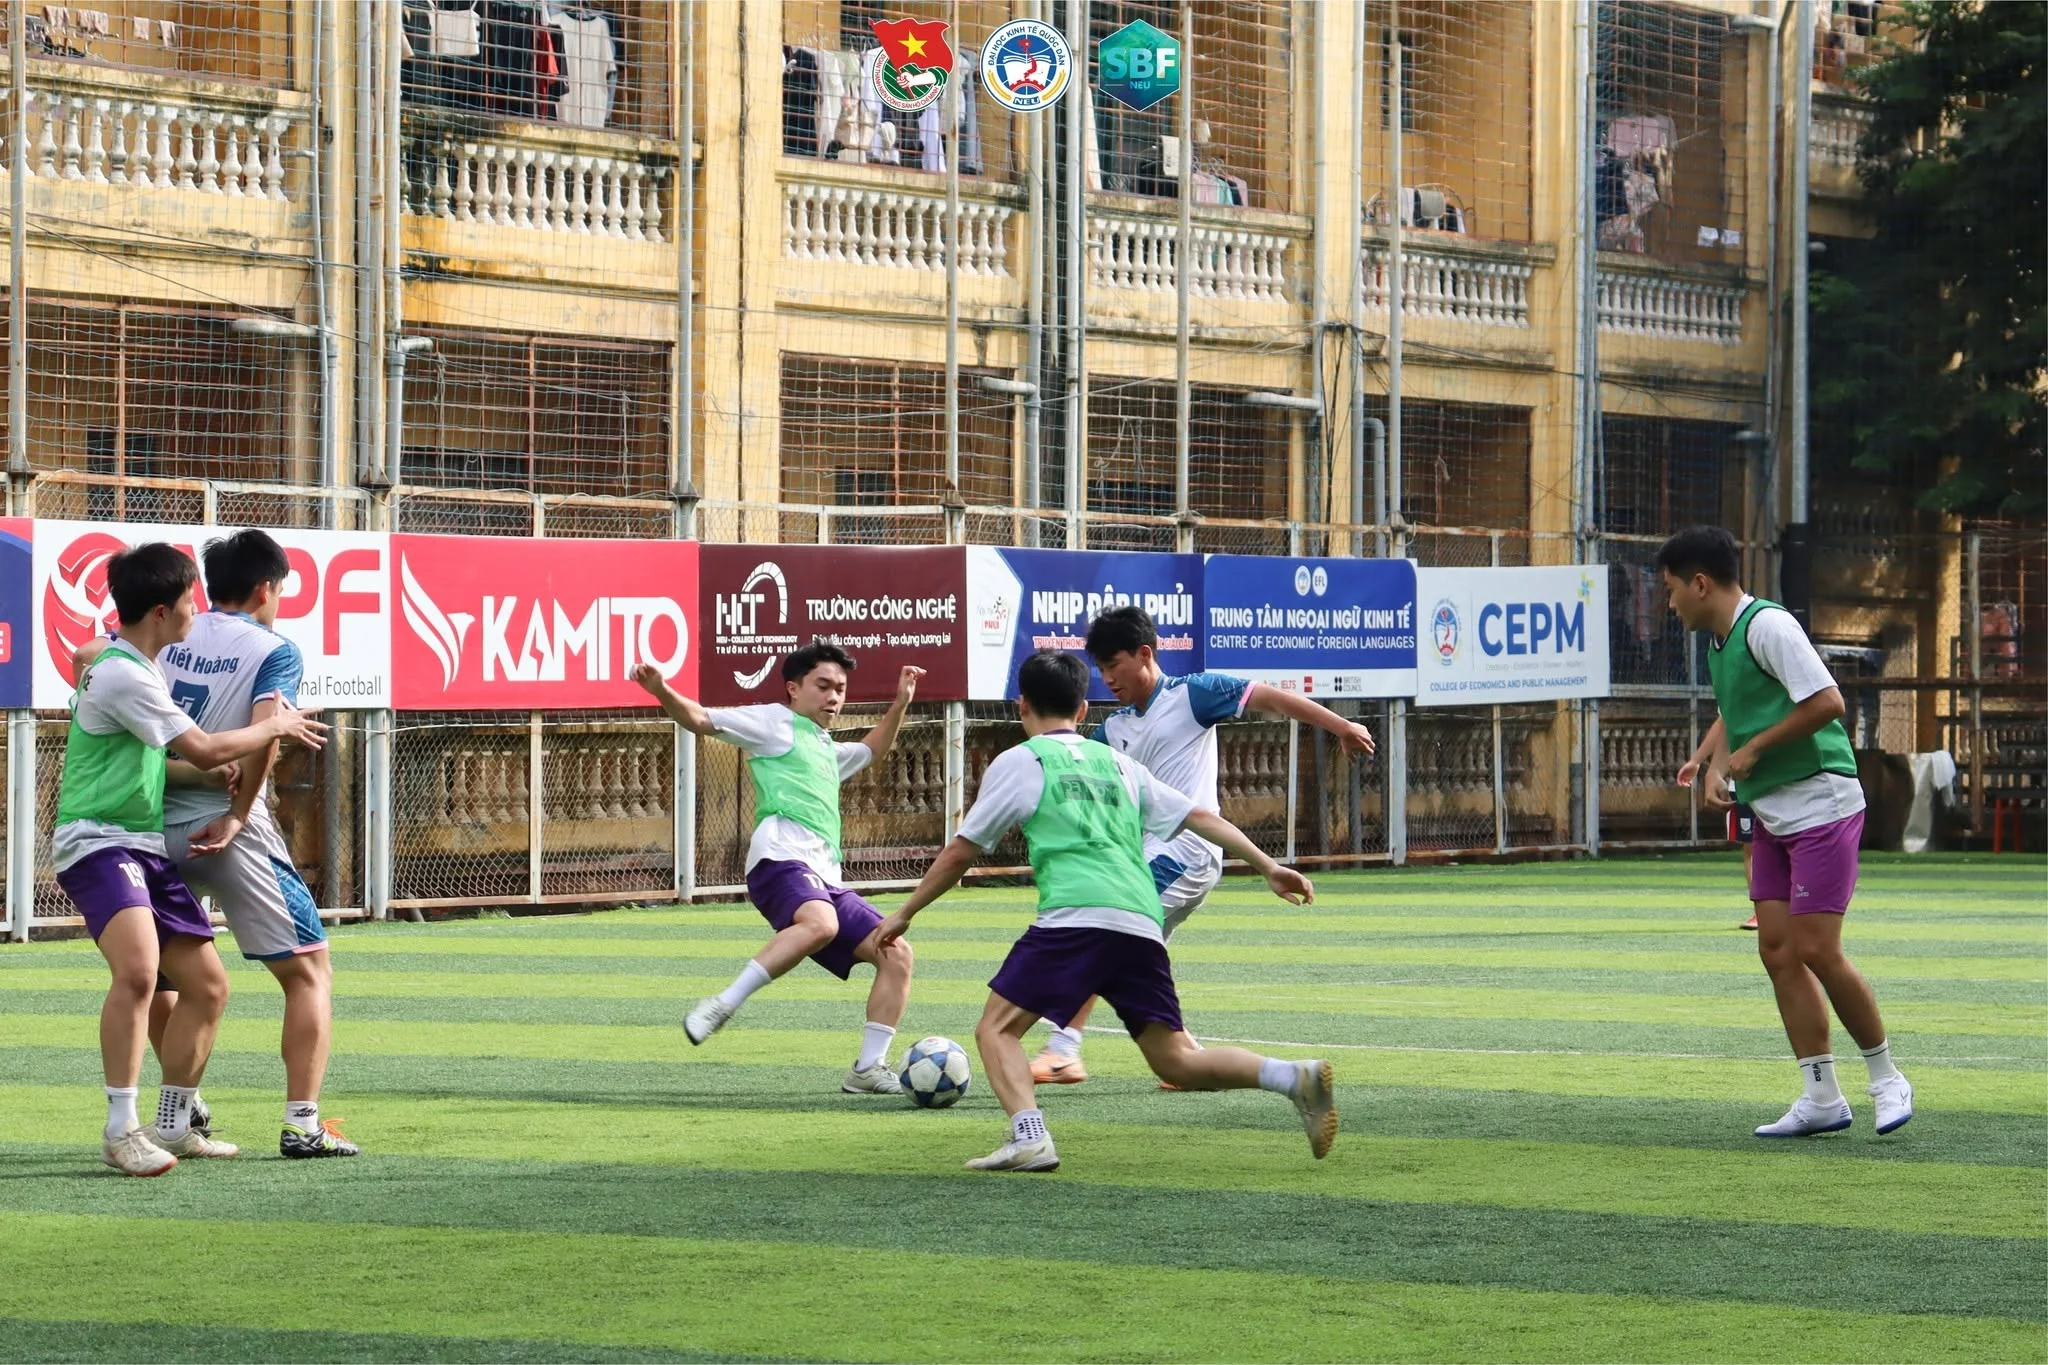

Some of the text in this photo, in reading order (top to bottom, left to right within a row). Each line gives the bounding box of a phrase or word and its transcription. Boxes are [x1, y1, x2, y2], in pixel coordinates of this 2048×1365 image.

[806, 594, 868, 620] TRƯỜNG
[870, 594, 913, 620] CÔNG
[916, 593, 957, 623] NGHỆ
[1032, 591, 1083, 633] NHỊP
[1145, 582, 1193, 625] PHỦI
[1210, 607, 1253, 628] TRUNG
[1256, 602, 1283, 628] TÂM
[1286, 608, 1329, 634] NGOẠI
[1364, 609, 1394, 629] KINH
[1397, 601, 1412, 629] TẾ
[483, 596, 689, 682] KAMITO
[843, 634, 861, 648] công
[862, 633, 881, 648] nghệ
[886, 632, 899, 647] Tạo
[1210, 634, 1415, 649] CENTRE OF ECONOMIC FOREIGN LANGUAGES
[1478, 601, 1585, 657] CEPM
[751, 644, 773, 654] CÔNG
[325, 676, 382, 696] Football
[1430, 676, 1588, 692] COLLEGE OF ECONOMICS AND PUBLIC MANAGEMENT
[118, 862, 146, 889] 19
